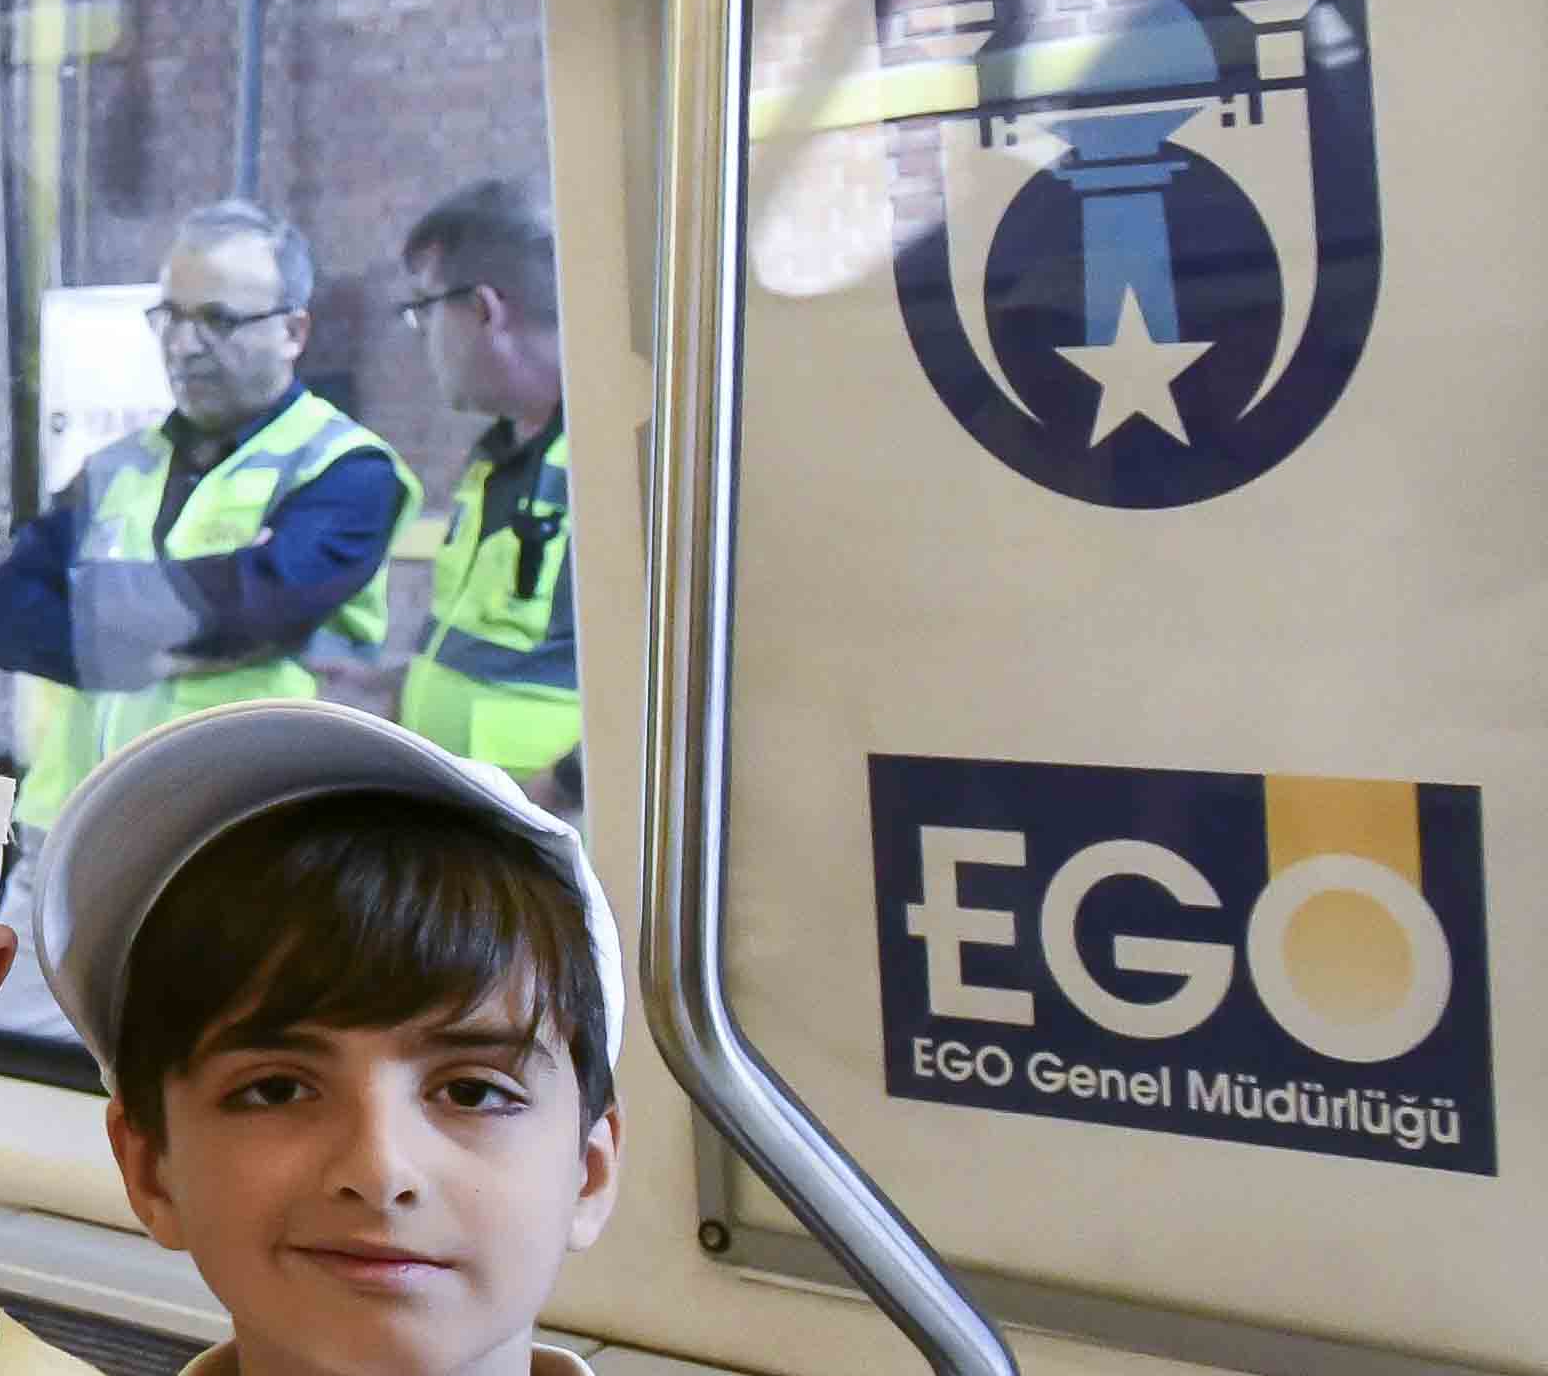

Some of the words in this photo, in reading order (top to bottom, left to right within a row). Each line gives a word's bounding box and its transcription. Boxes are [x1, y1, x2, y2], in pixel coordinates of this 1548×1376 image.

[907, 824, 1453, 1063] EGO
[912, 1036, 1013, 1087] EGO
[1027, 1052, 1172, 1108] Genel
[1187, 1067, 1462, 1151] Müdürlüğü
